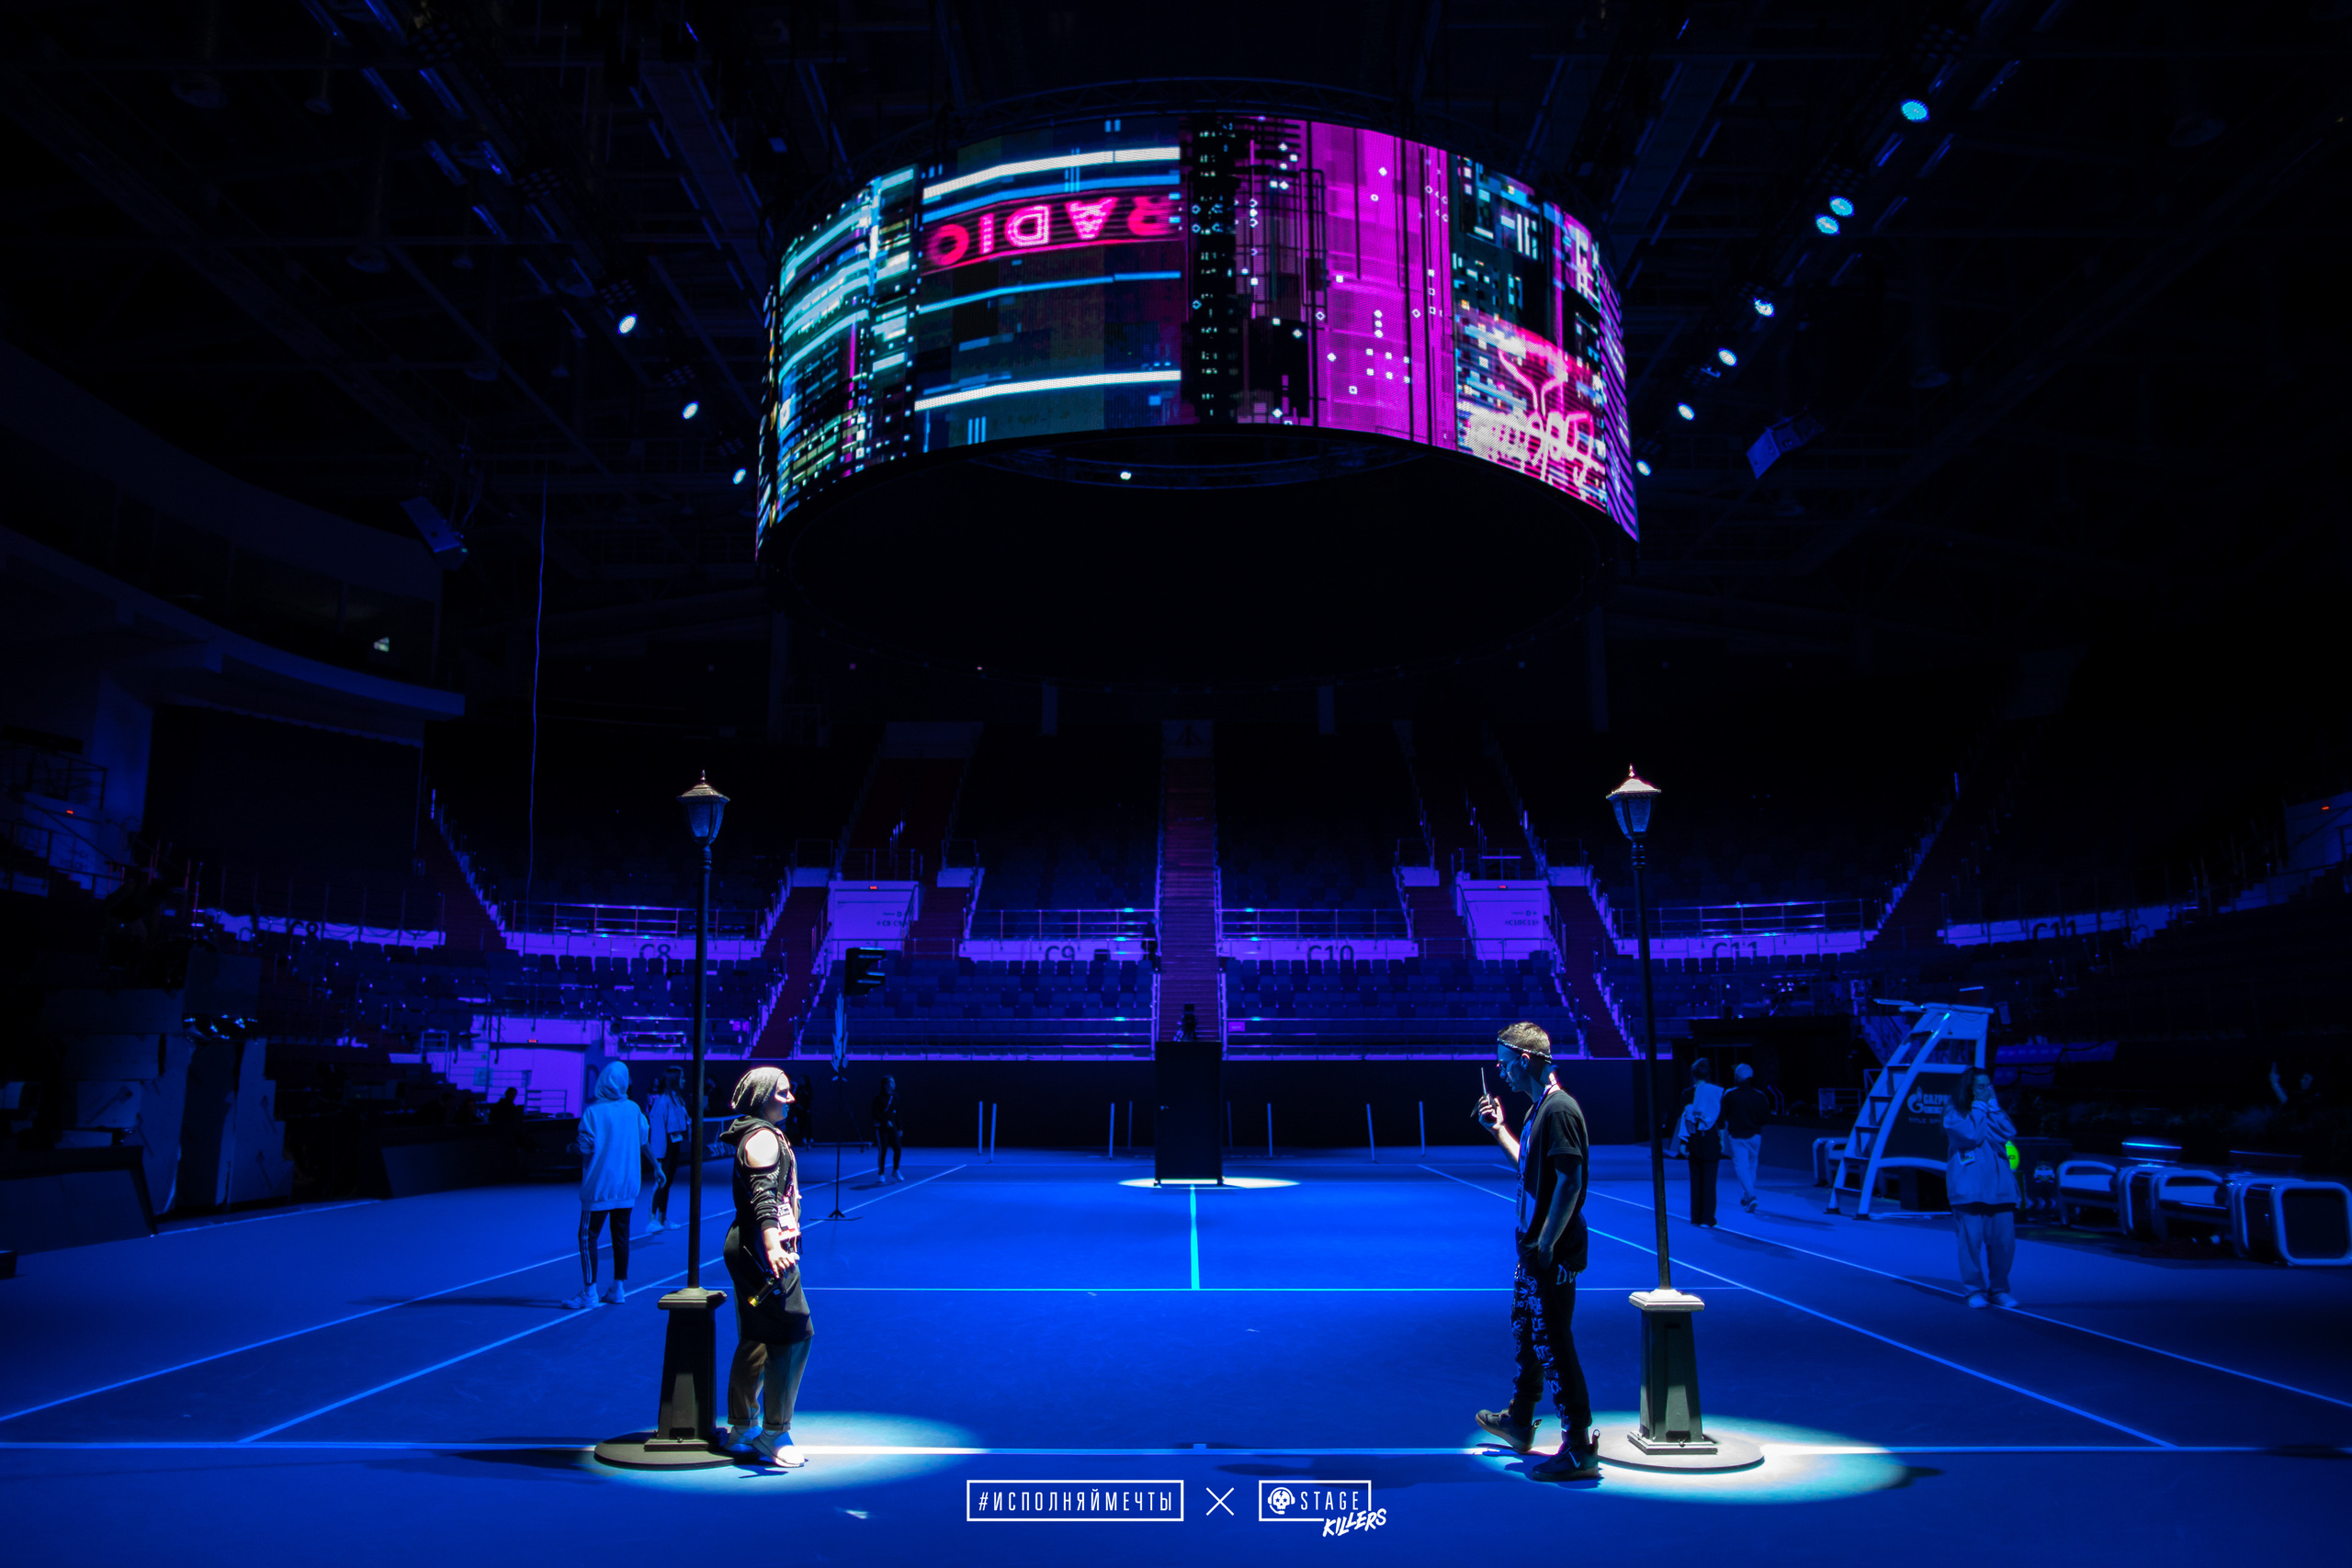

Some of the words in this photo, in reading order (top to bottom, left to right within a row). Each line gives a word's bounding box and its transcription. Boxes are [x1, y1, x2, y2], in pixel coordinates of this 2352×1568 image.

[925, 196, 1173, 266] RADIO
[639, 942, 672, 960] C8
[1045, 945, 1075, 962] C9
[1306, 944, 1354, 961] C10
[1712, 941, 1758, 959] C11
